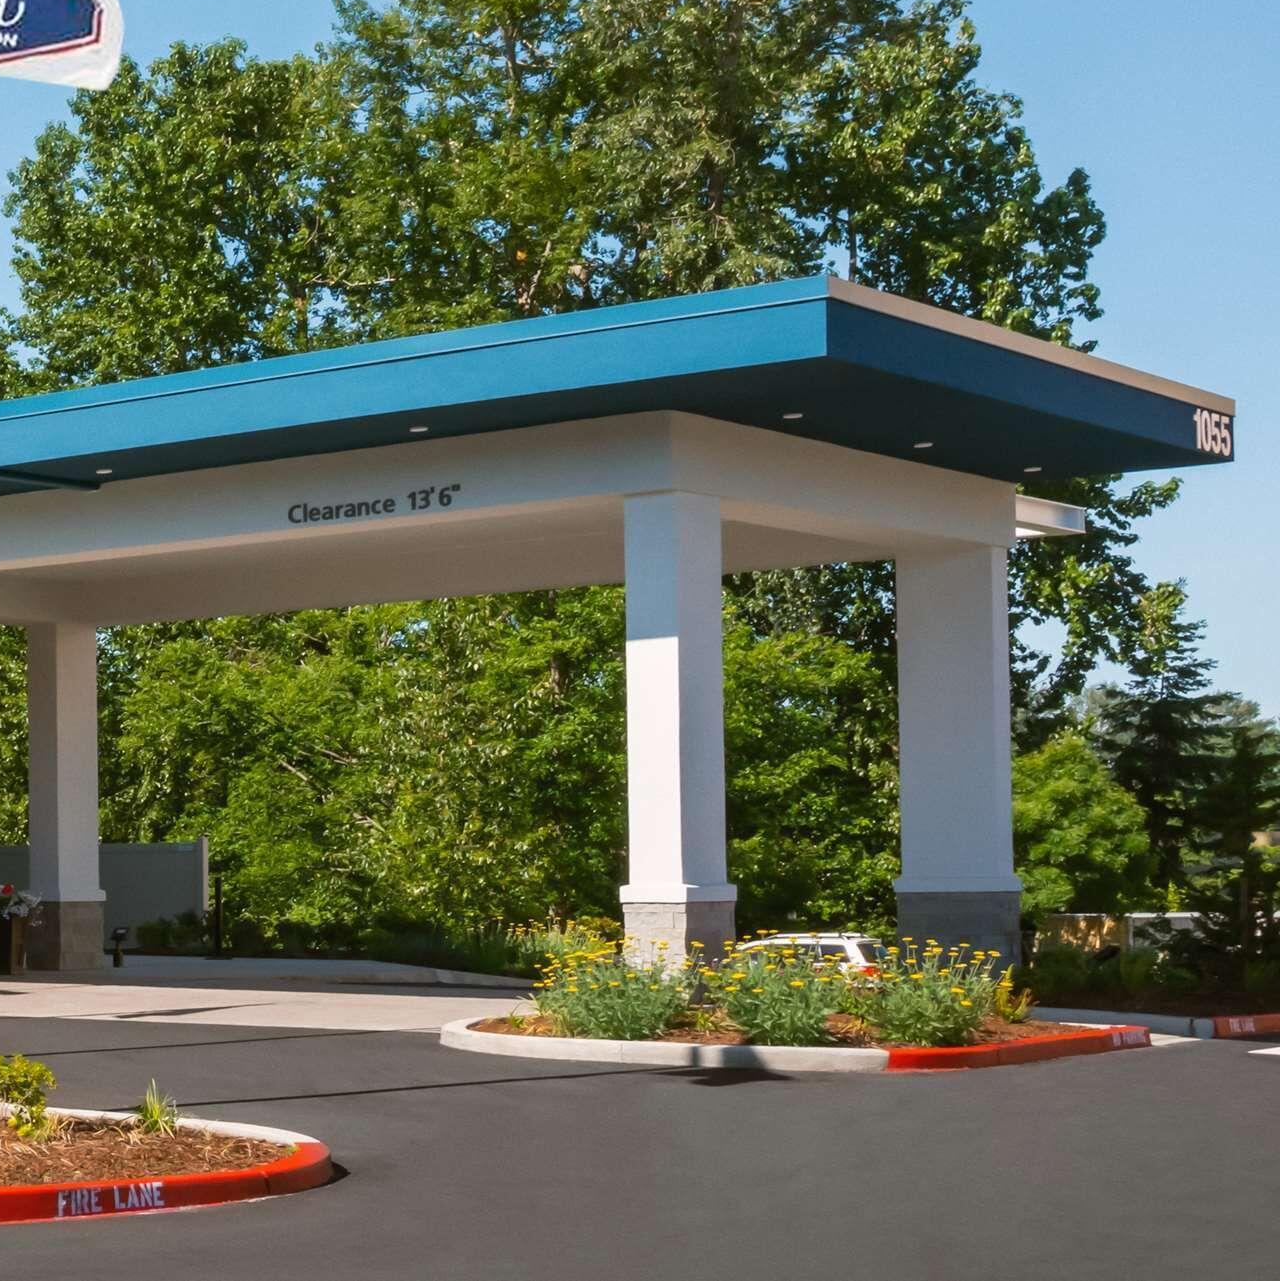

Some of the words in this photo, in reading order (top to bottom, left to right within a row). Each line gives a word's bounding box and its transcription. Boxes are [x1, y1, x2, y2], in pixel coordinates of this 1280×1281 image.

[1193, 407, 1232, 457] 1055
[288, 496, 396, 524] Clearance
[57, 1188, 103, 1217] FIRE
[113, 1181, 165, 1209] LANE
